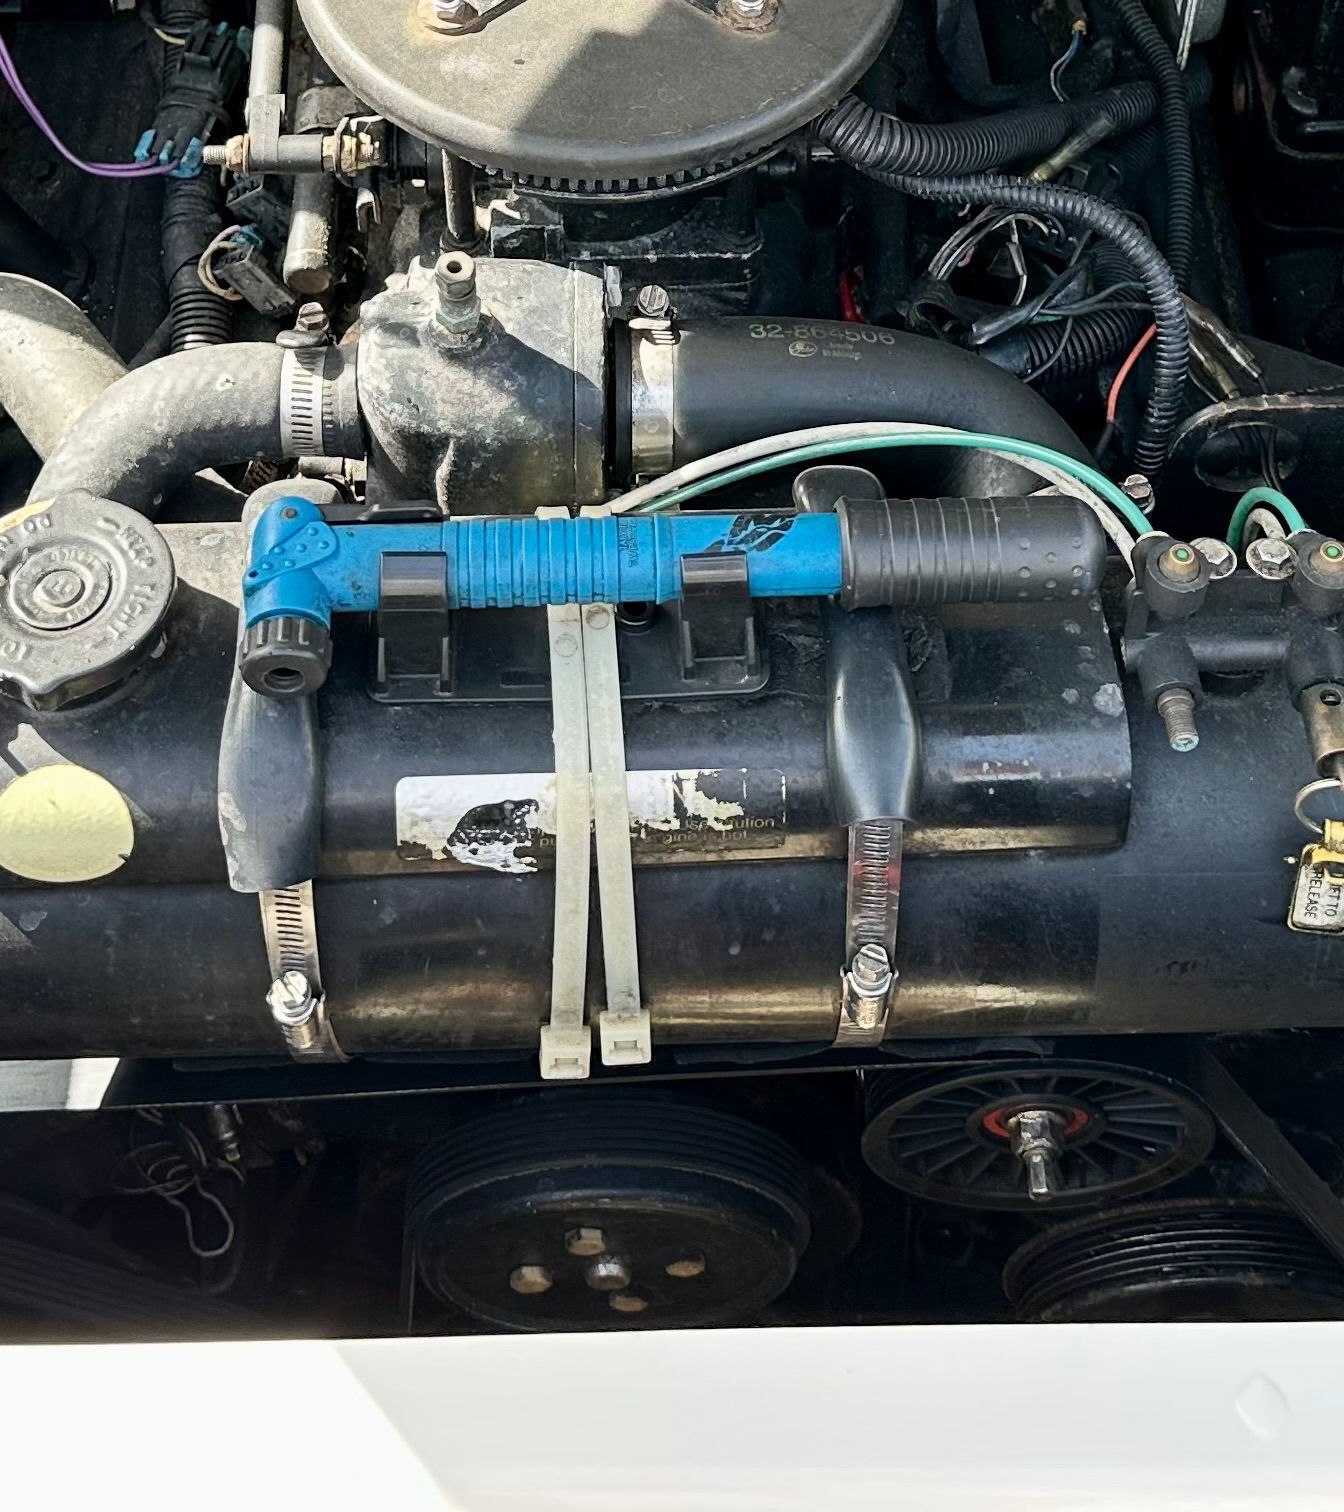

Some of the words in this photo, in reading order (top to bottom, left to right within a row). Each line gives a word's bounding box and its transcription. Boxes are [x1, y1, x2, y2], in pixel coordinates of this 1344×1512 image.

[748, 323, 896, 345] 32-864506
[107, 584, 156, 639] TIGHT
[1304, 870, 1324, 919] RELEASE
[1324, 902, 1340, 917] TO
